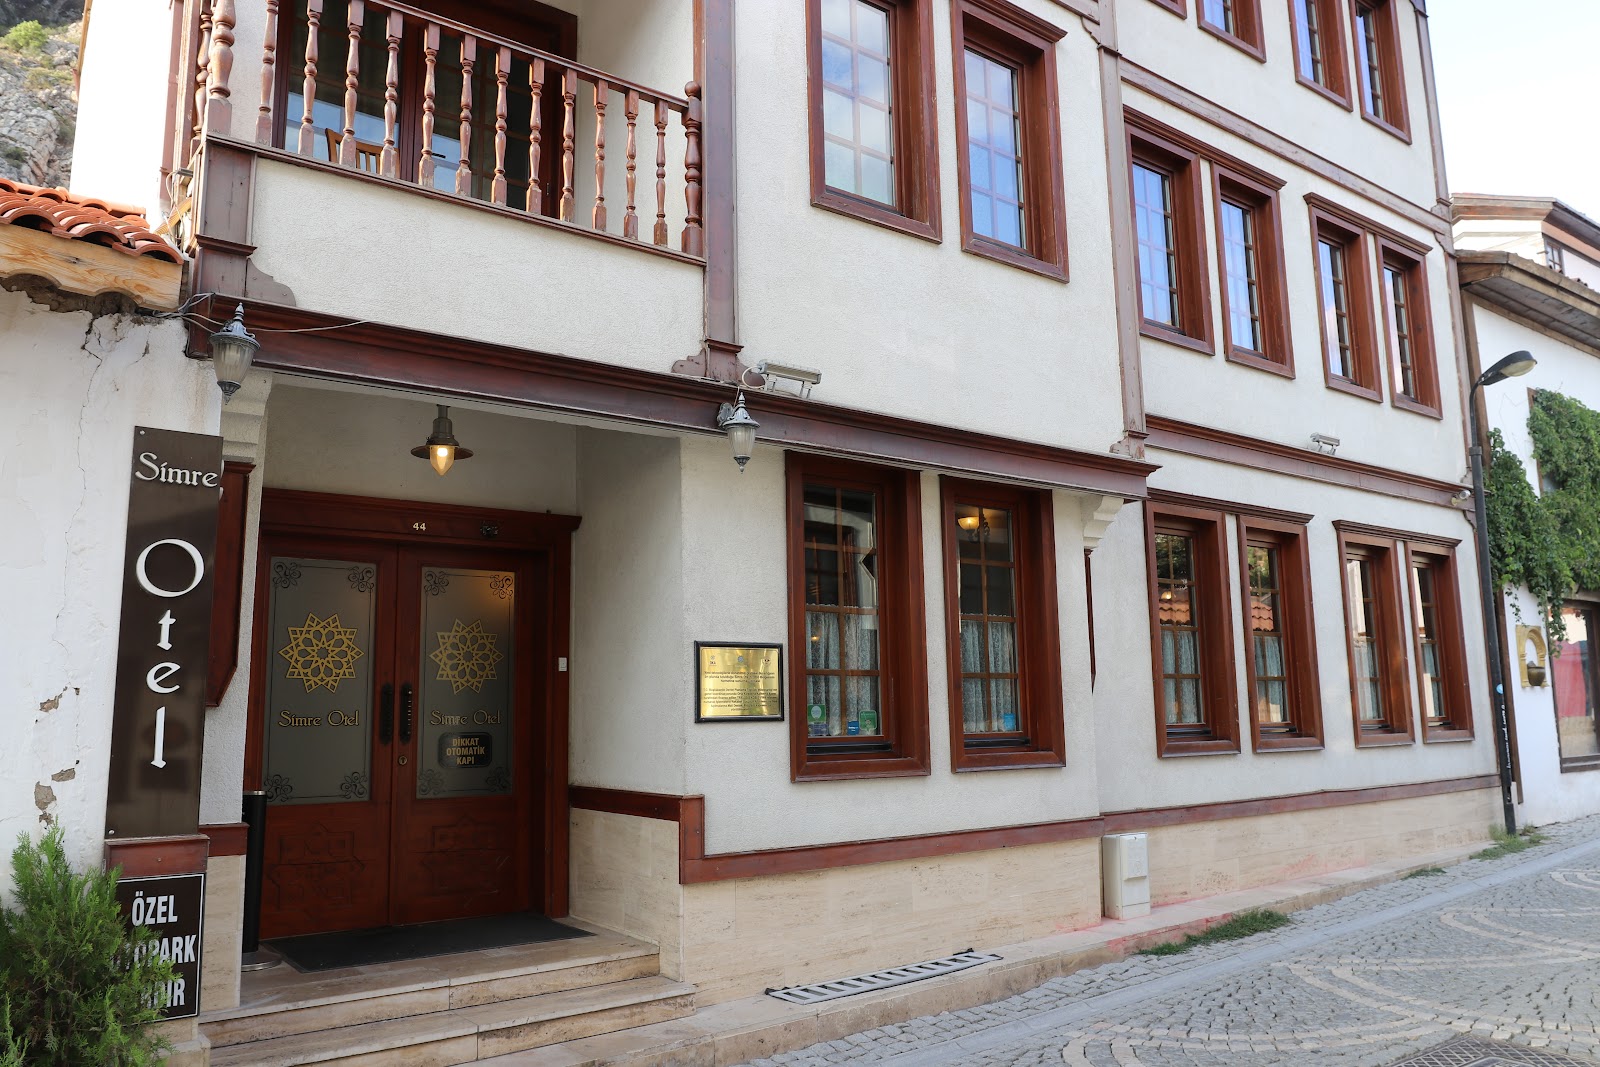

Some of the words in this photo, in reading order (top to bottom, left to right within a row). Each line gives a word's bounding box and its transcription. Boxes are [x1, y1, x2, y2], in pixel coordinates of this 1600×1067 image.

[412, 522, 427, 531] 44
[135, 538, 206, 769] Otel
[328, 710, 359, 726] Otel
[473, 709, 501, 725] Otel
[452, 737, 480, 747] DİKKAT
[446, 746, 486, 756] OTOMATİK
[456, 756, 475, 765] KAPI
[131, 890, 178, 927] ÖZEL
